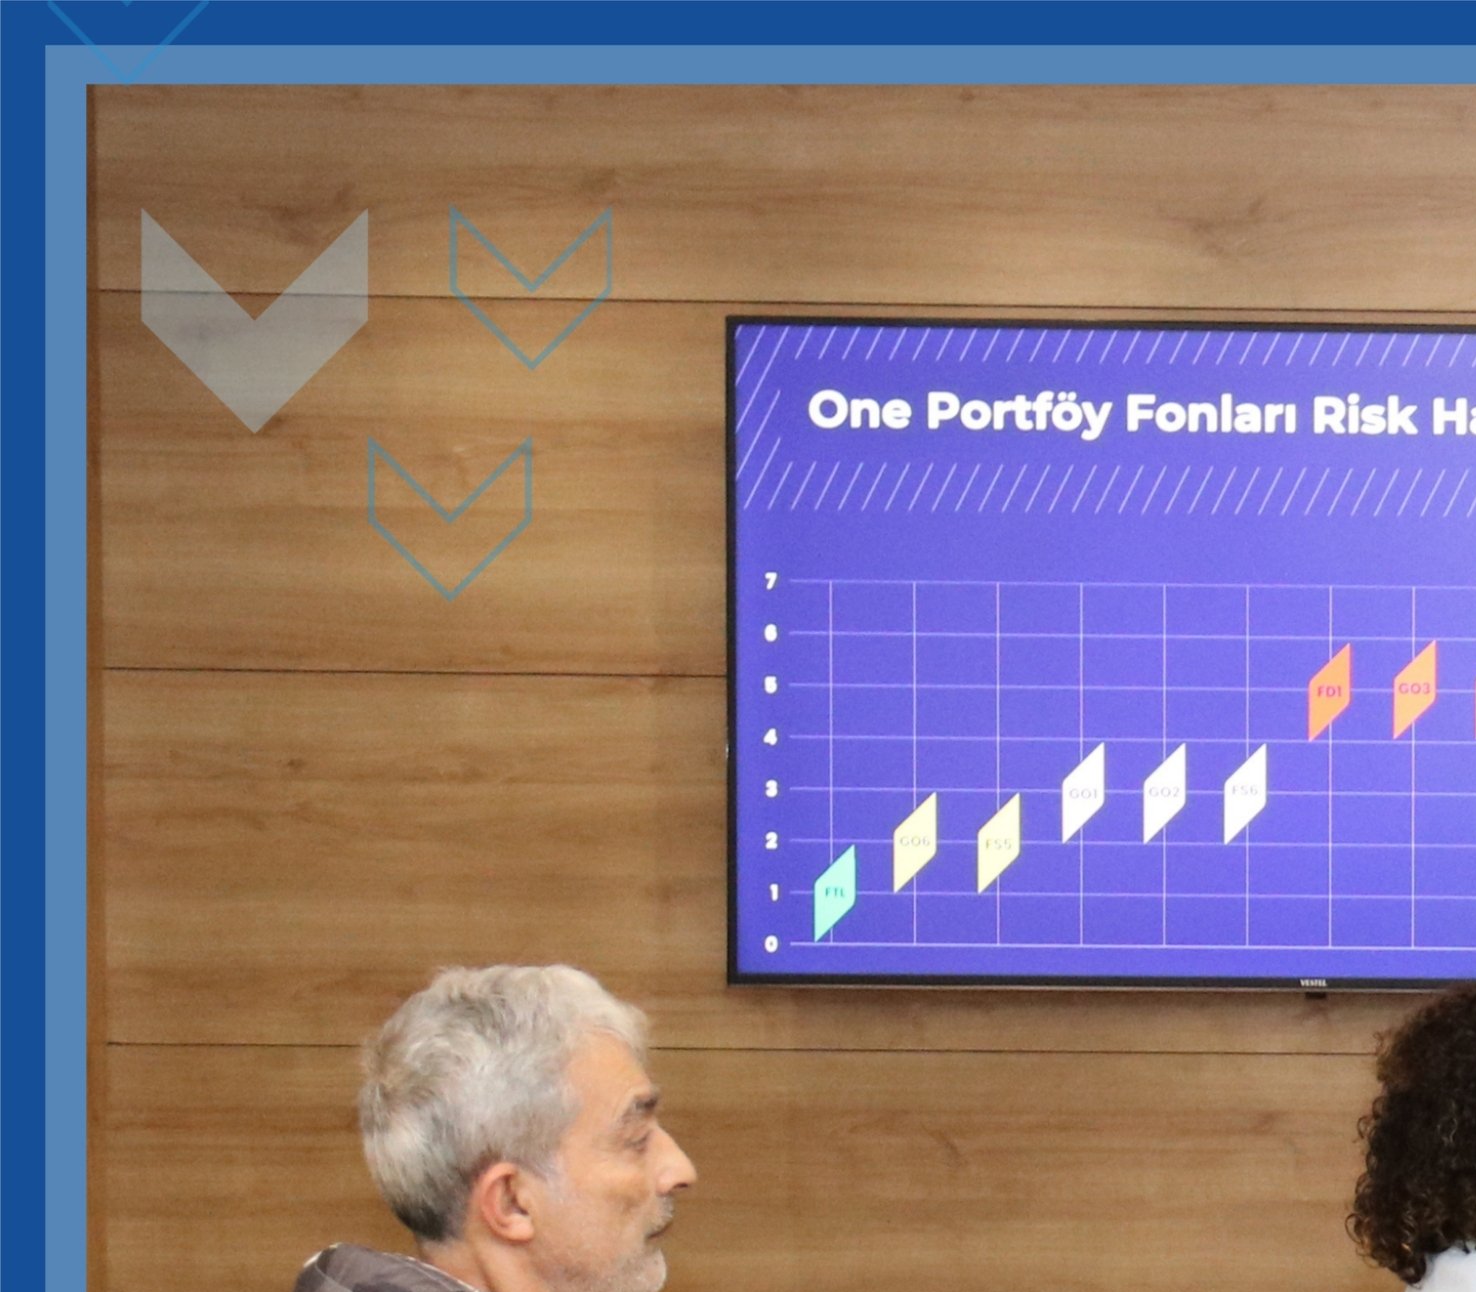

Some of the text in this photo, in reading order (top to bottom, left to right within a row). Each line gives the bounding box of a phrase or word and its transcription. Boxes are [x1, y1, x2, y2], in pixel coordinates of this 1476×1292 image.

[808, 389, 912, 429] One
[927, 391, 1113, 441] Portföy
[1126, 393, 1297, 434] Fonları
[1313, 393, 1419, 435] Risk
[764, 572, 778, 591] 7
[764, 624, 777, 642] 6
[764, 676, 777, 694] 5
[763, 728, 778, 746] 4
[765, 779, 778, 798] 3
[765, 831, 778, 850] 2
[769, 883, 779, 902] 1
[764, 935, 778, 953] 0
